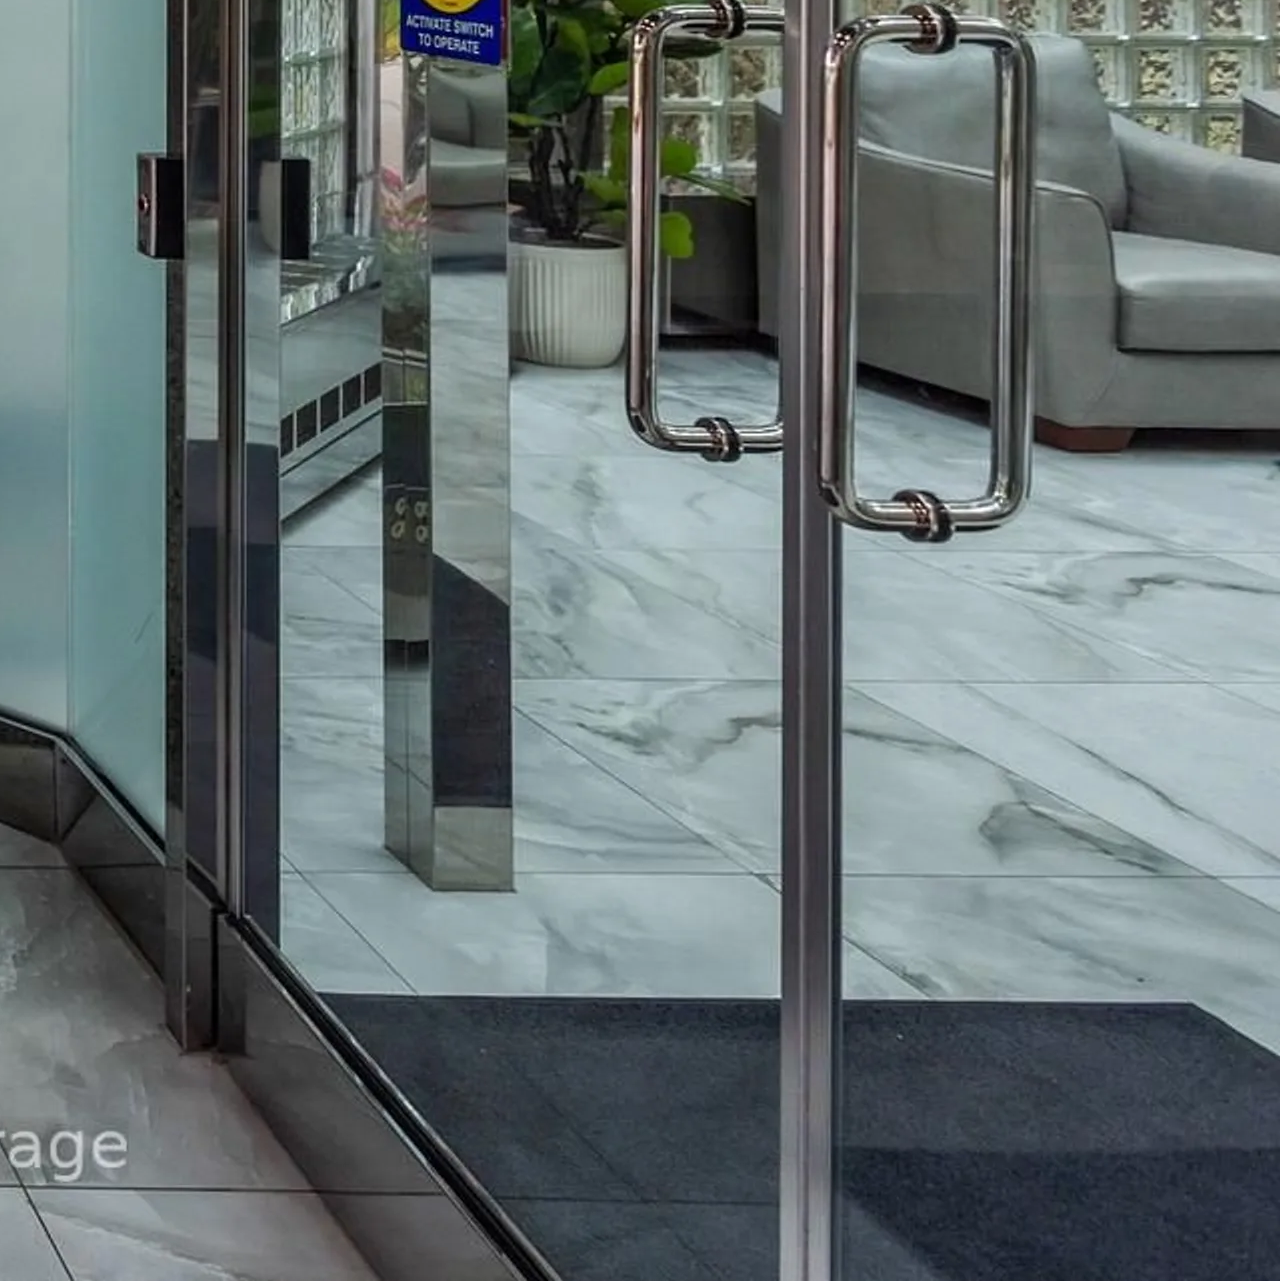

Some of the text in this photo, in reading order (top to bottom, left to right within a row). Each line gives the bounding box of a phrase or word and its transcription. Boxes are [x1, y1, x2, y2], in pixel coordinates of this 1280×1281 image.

[406, 15, 494, 39] ACTIVATE SWITCH
[418, 32, 481, 55] TO OPERATE
